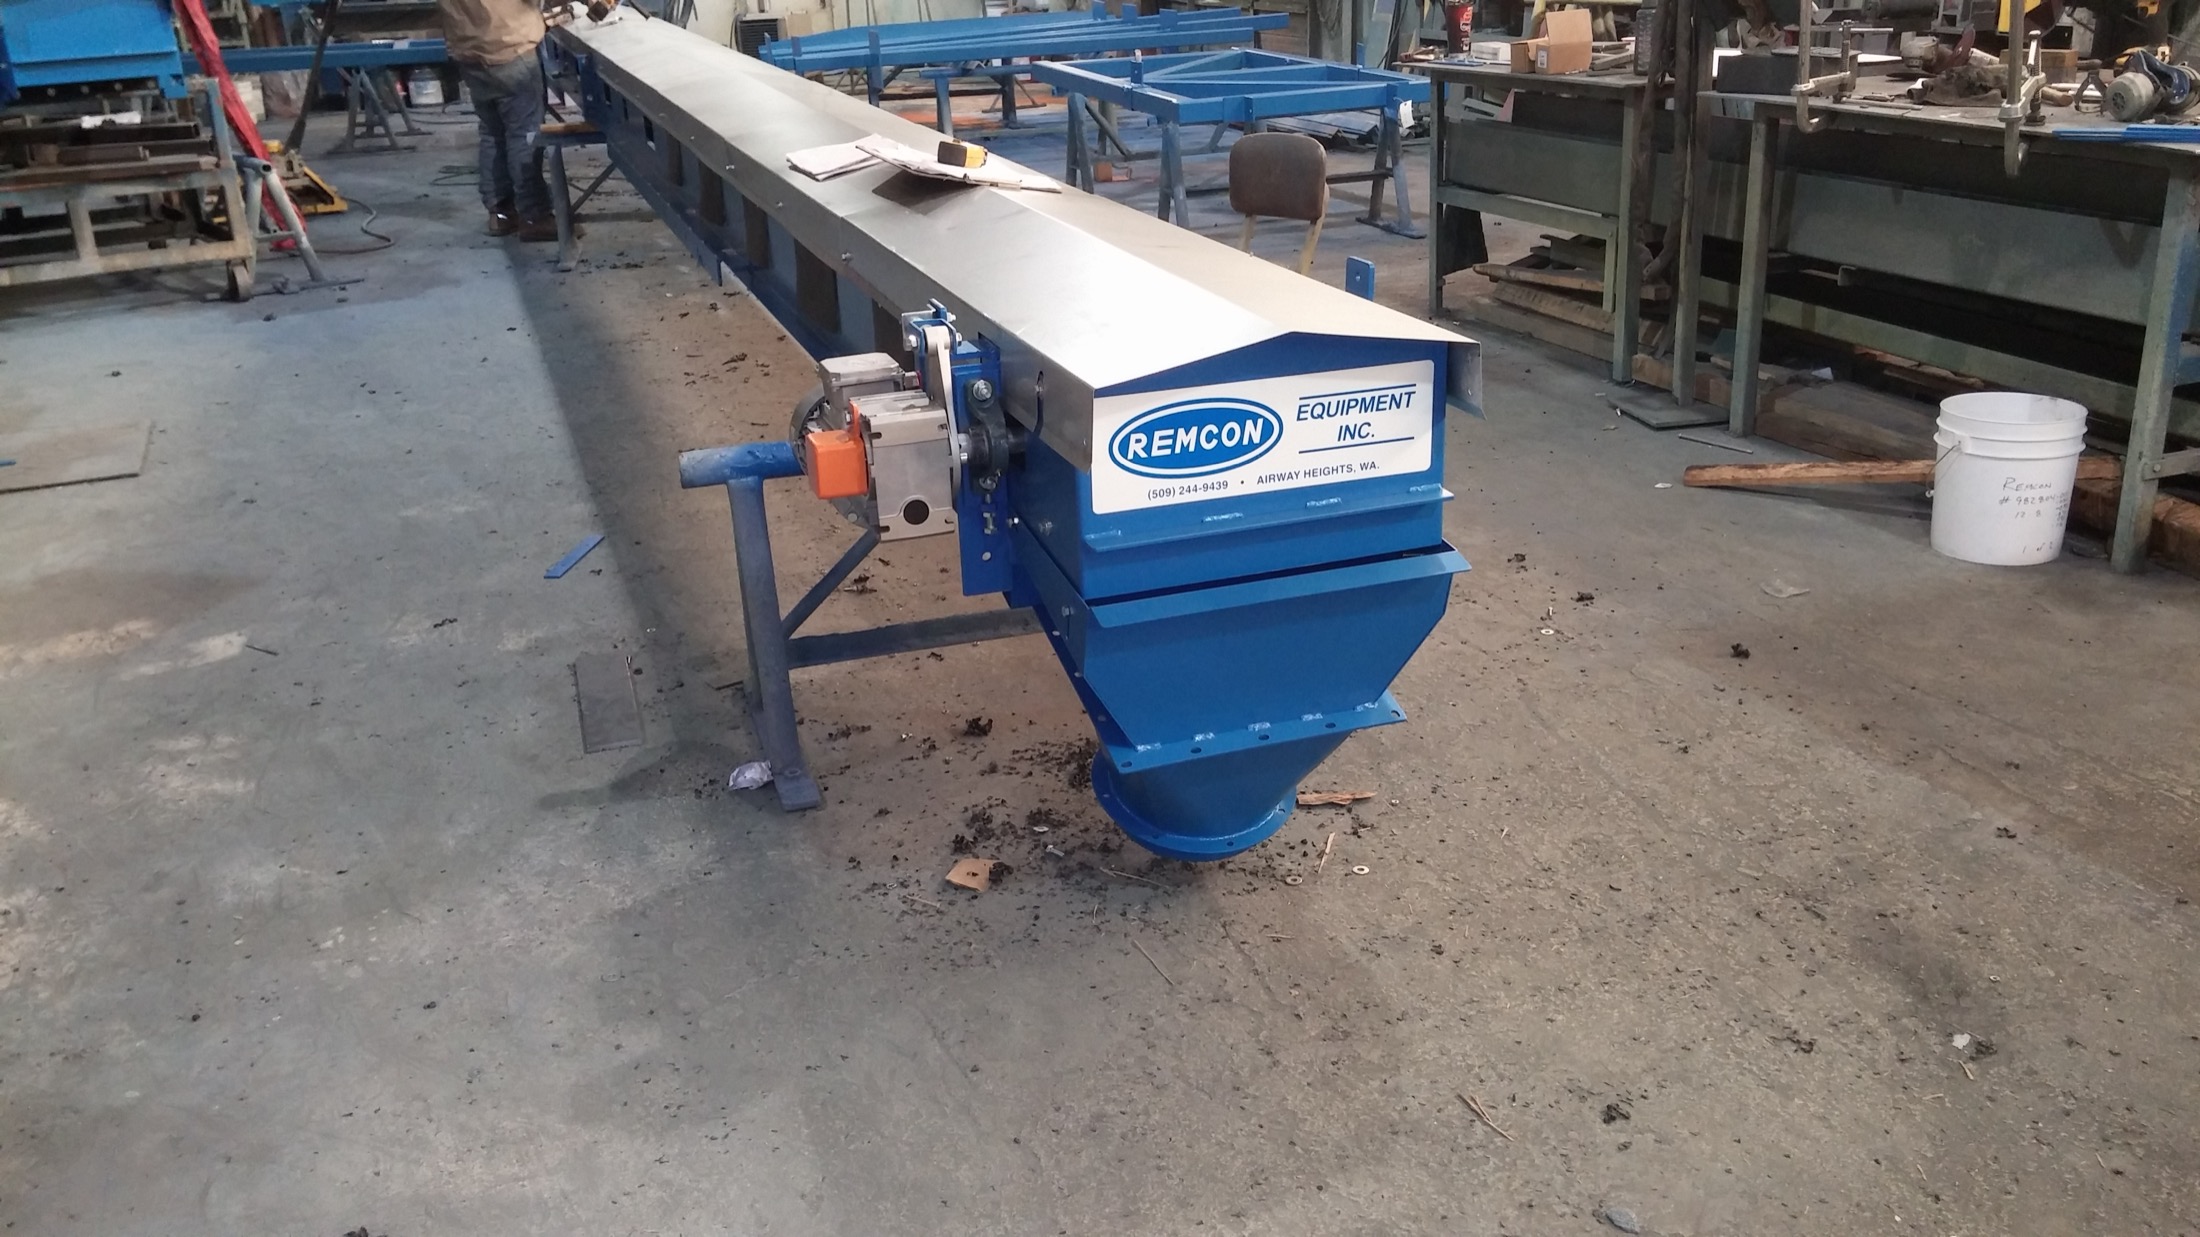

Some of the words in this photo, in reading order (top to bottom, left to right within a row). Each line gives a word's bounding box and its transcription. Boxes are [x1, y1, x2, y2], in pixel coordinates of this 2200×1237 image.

[1296, 391, 1416, 422] EQUIPMENT
[1127, 418, 1264, 460] REMCON
[1337, 422, 1375, 442] INC.
[1257, 470, 1301, 485] AIRWAY
[1303, 463, 1356, 479] HEIGHTS,
[1359, 461, 1380, 472] WA.
[1147, 484, 1176, 501] (509)
[1178, 480, 1229, 496] 244-9439
